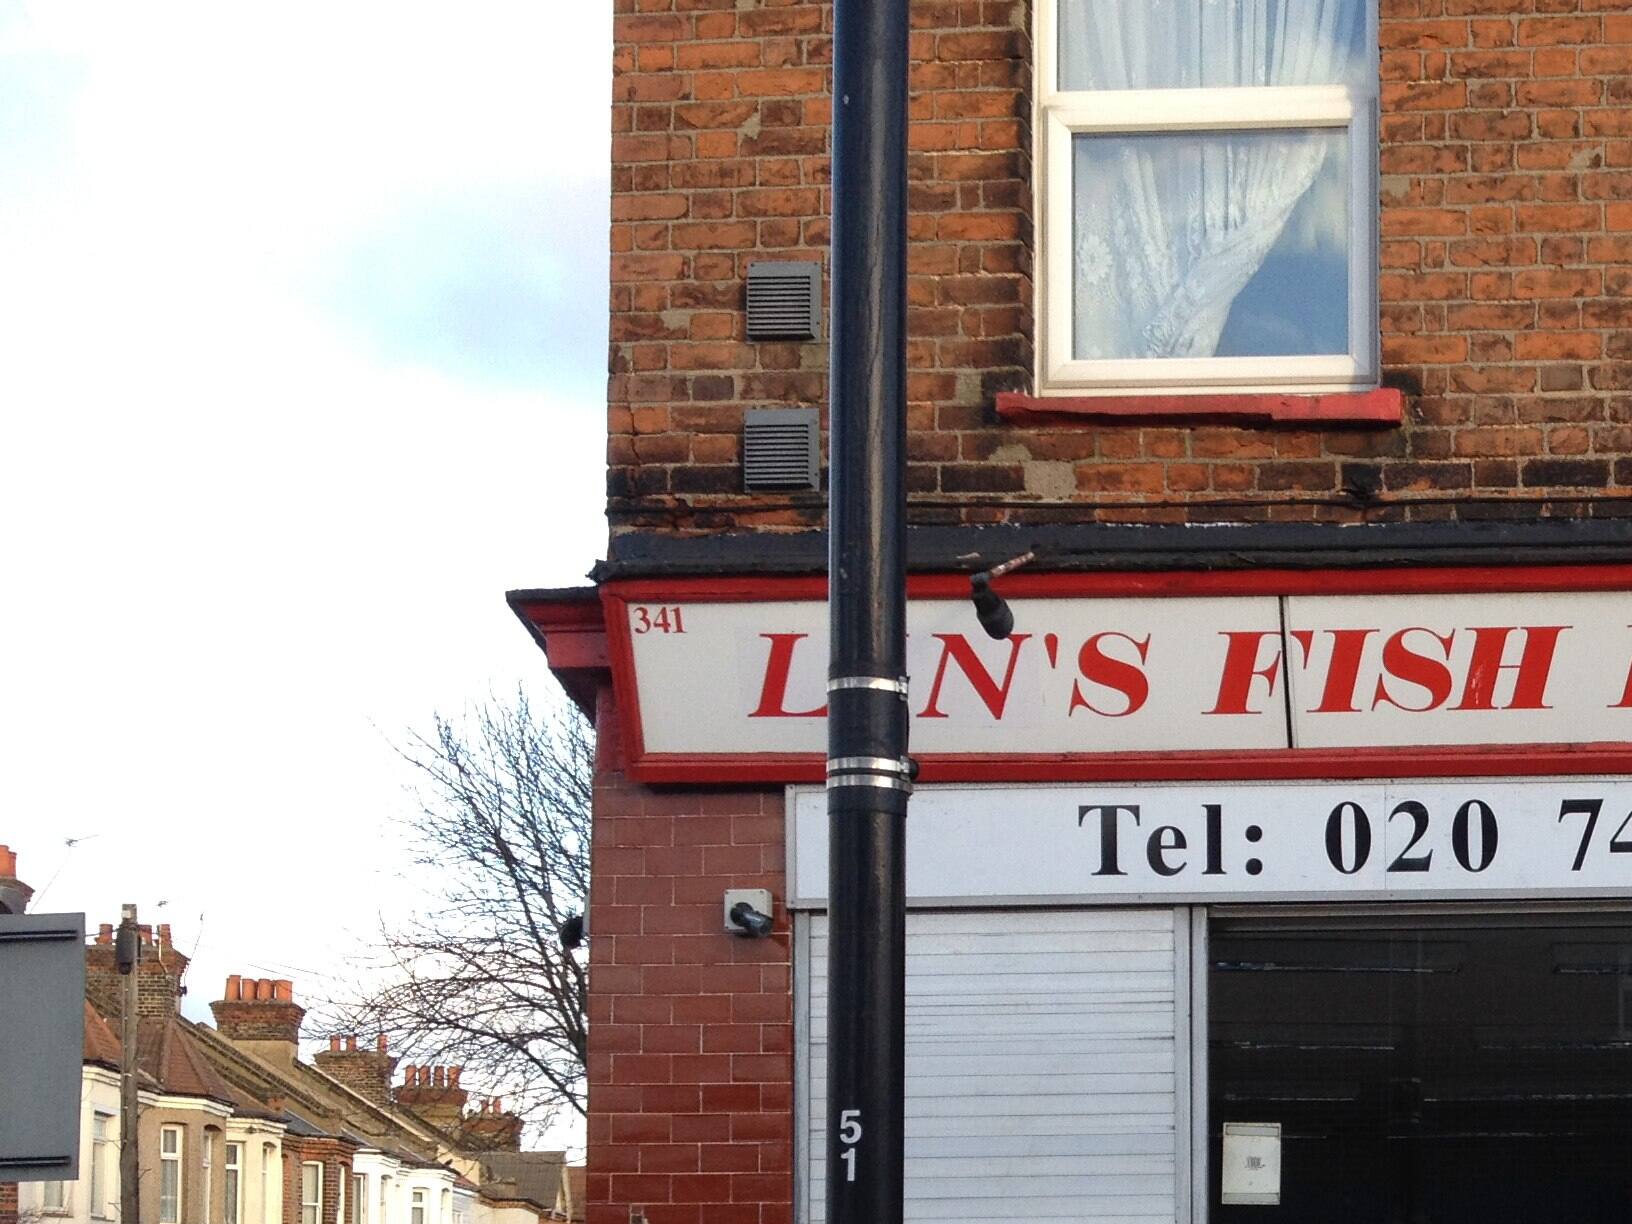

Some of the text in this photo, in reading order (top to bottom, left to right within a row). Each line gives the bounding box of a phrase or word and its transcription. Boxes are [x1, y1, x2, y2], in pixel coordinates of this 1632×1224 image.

[634, 606, 687, 634] 341
[747, 631, 1152, 721] LN'S
[1200, 625, 1573, 714] FISH
[1077, 803, 1264, 877] Tel:
[1324, 799, 1499, 875] 020
